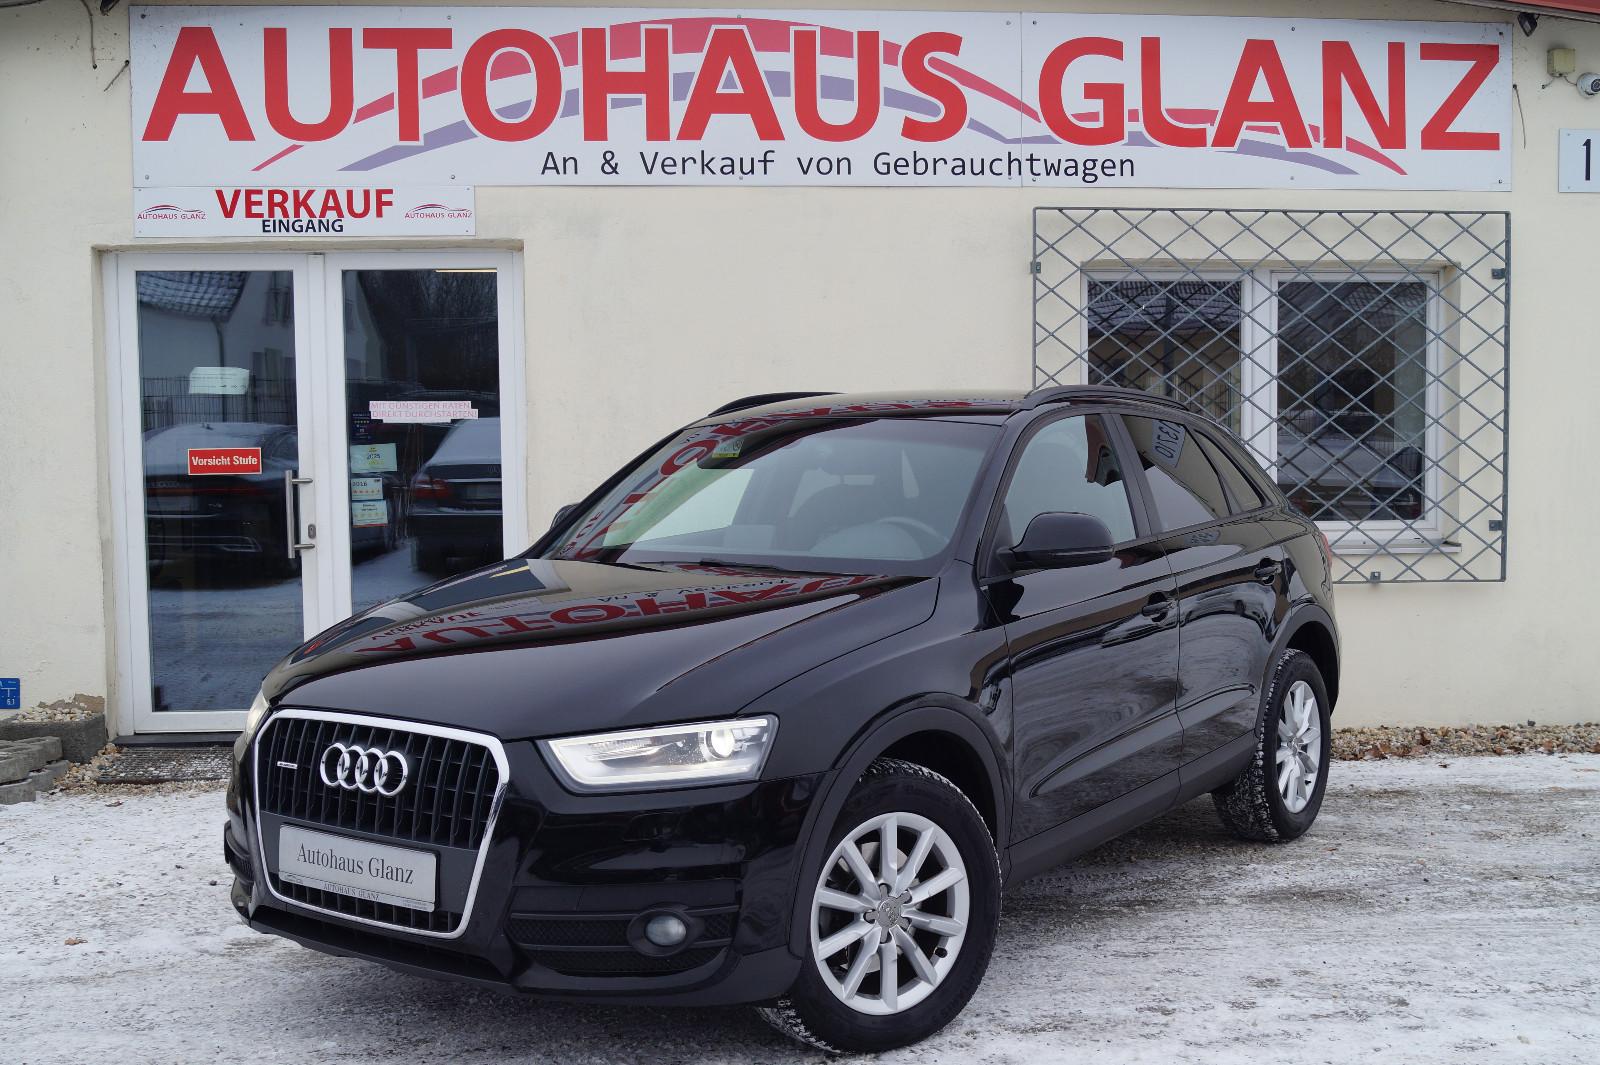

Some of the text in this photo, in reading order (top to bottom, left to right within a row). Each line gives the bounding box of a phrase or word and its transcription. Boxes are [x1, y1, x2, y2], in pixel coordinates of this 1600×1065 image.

[142, 27, 1500, 151] AUTOHAUS GLANZ
[541, 150, 1135, 183] An & Verkauf von Gebrauchtwagen
[215, 188, 394, 218] VERKAUF
[262, 219, 344, 233] EINGANG
[370, 402, 386, 410] MIT
[442, 402, 470, 410] RATEN
[372, 410, 403, 418] DIREKT
[191, 455, 258, 466] Vorsicht Stufe
[296, 843, 414, 885] Autohaus Glanz
[323, 883, 380, 902] AUTOHAUS GLANZ
